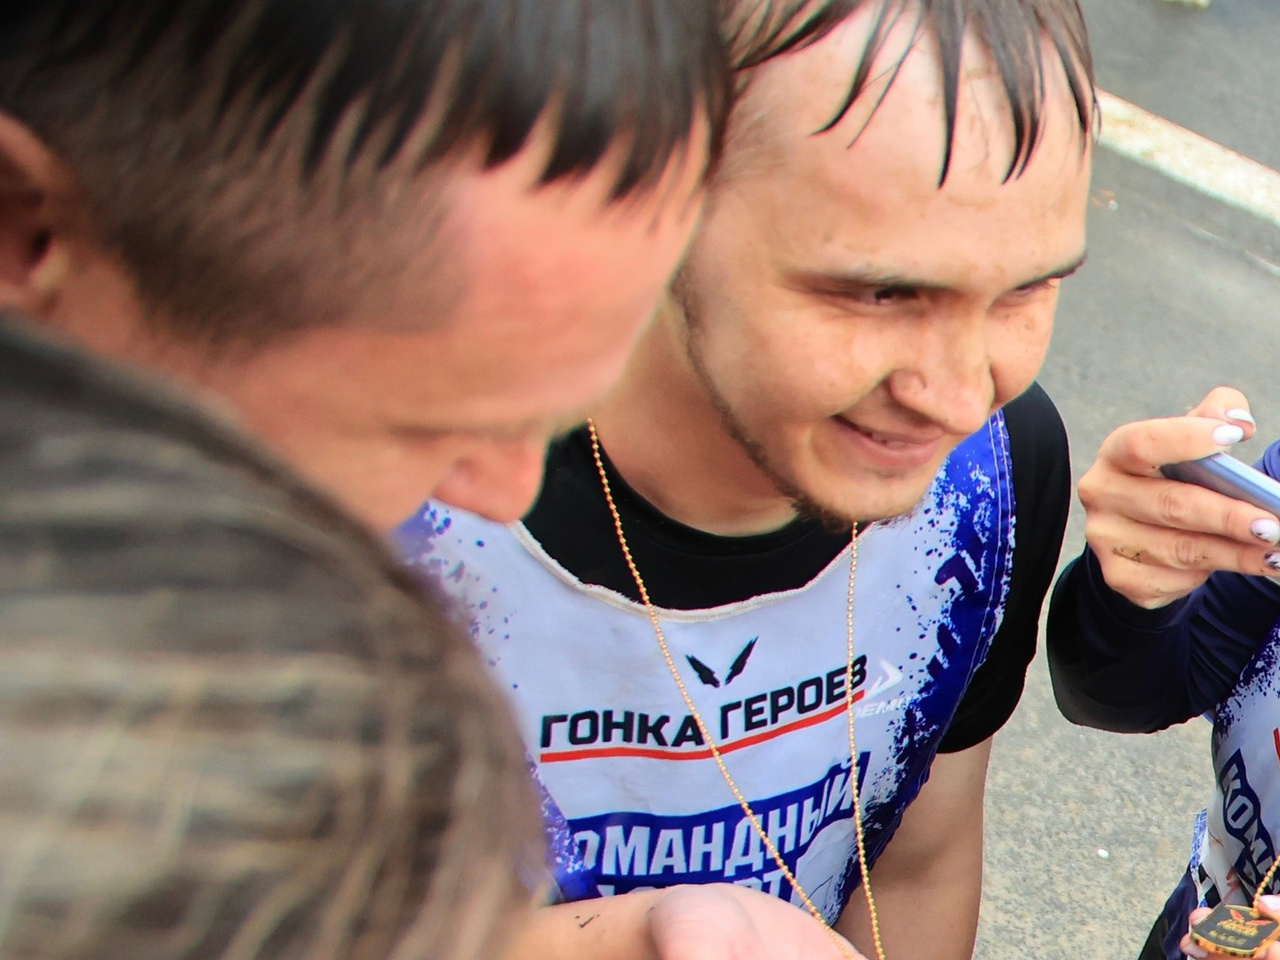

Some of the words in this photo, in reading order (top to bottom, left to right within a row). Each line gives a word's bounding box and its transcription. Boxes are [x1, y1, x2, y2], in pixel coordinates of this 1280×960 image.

[540, 709, 706, 748] ГОНКА
[720, 654, 868, 740] ГЕРОЕВ
[573, 760, 854, 878] ОМАНДНЫЙ
